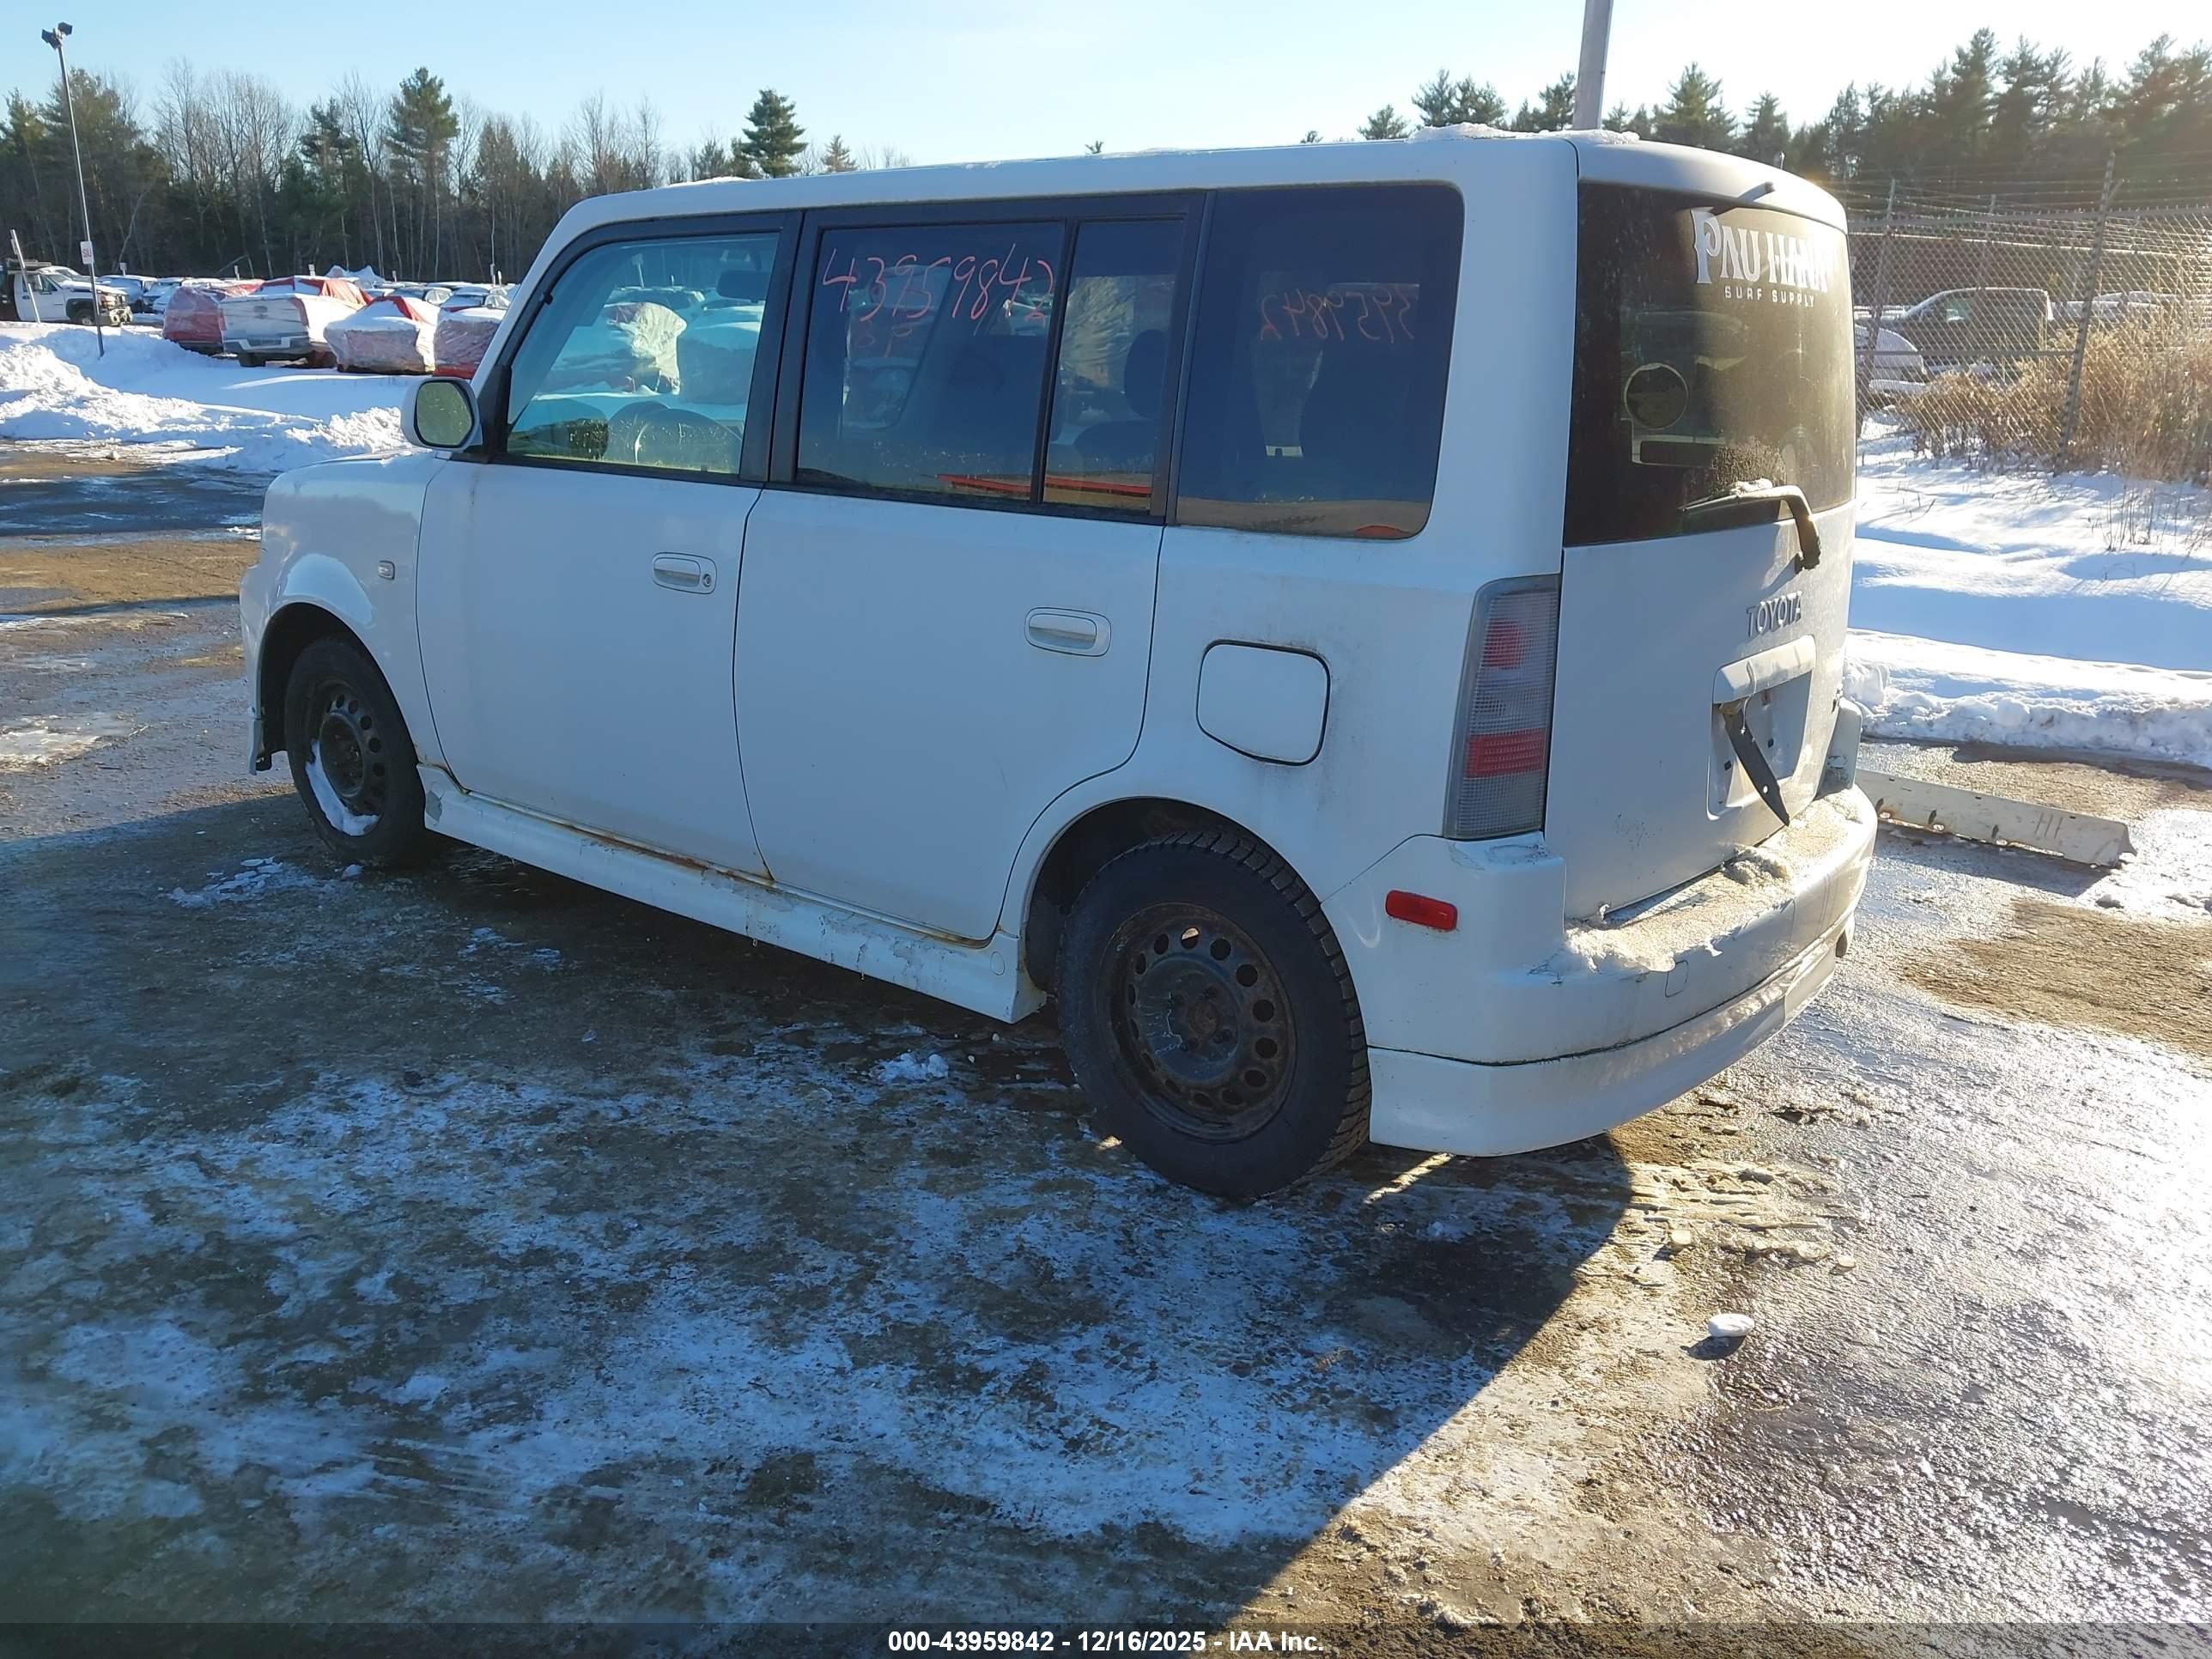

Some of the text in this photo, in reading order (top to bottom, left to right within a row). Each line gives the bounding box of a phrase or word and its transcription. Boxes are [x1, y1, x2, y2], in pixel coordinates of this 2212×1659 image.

[822, 242, 1054, 326] 43959842
[1724, 285, 1814, 308] SURF SUPPLY
[1745, 592, 1803, 639] TOYOTA
